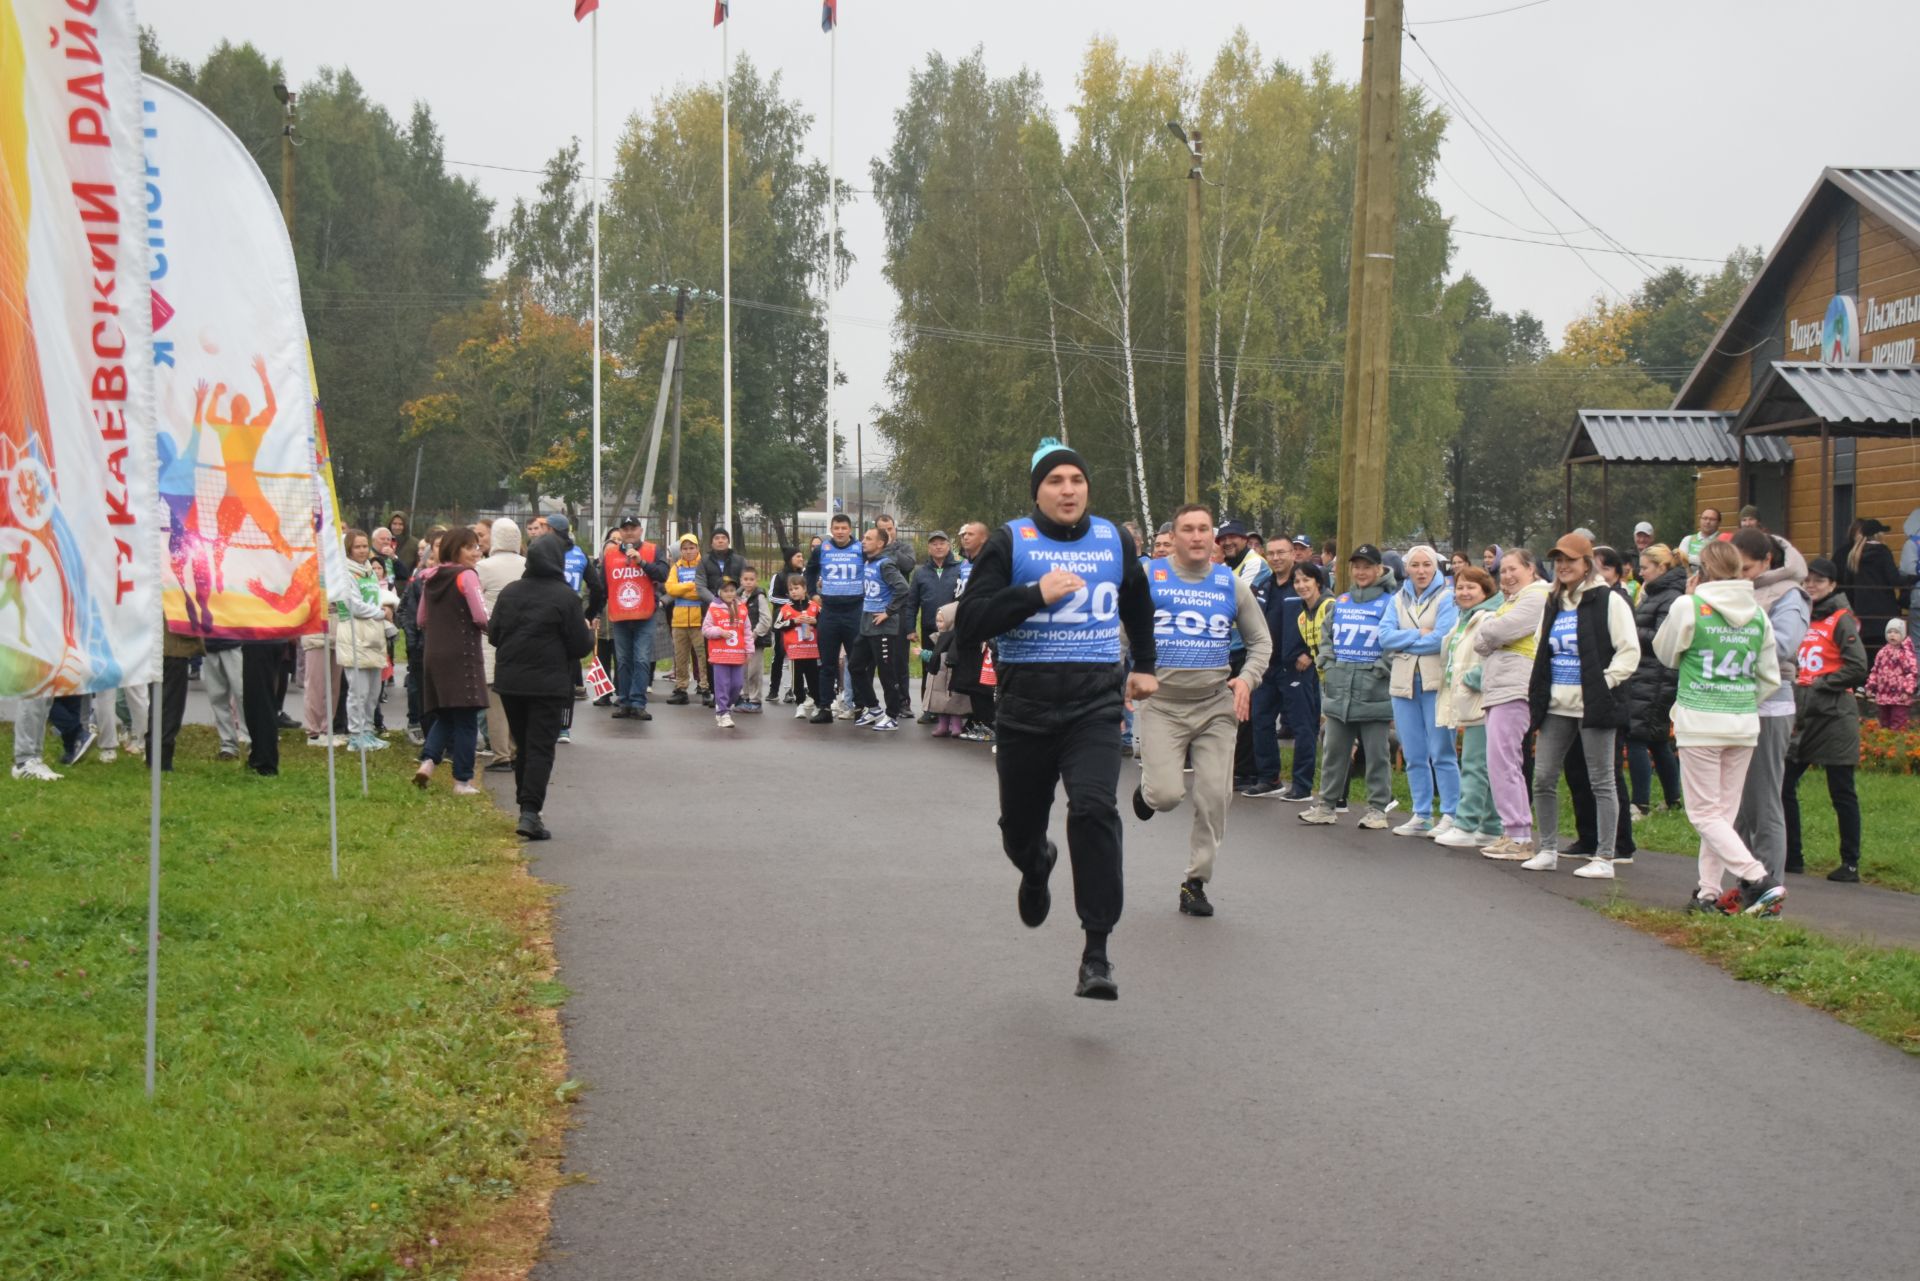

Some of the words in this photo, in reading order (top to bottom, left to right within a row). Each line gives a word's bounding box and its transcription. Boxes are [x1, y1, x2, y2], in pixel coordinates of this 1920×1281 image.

[1028, 549, 1114, 562] ТУКАЕВСКИЙ
[824, 563, 857, 580] 211
[1050, 561, 1098, 573] РАЙОН
[1156, 588, 1227, 602] ТУКАЕВСКИЙ
[1173, 596, 1212, 608] РАЙОН
[1153, 608, 1231, 639] 208
[1332, 622, 1379, 648] 277
